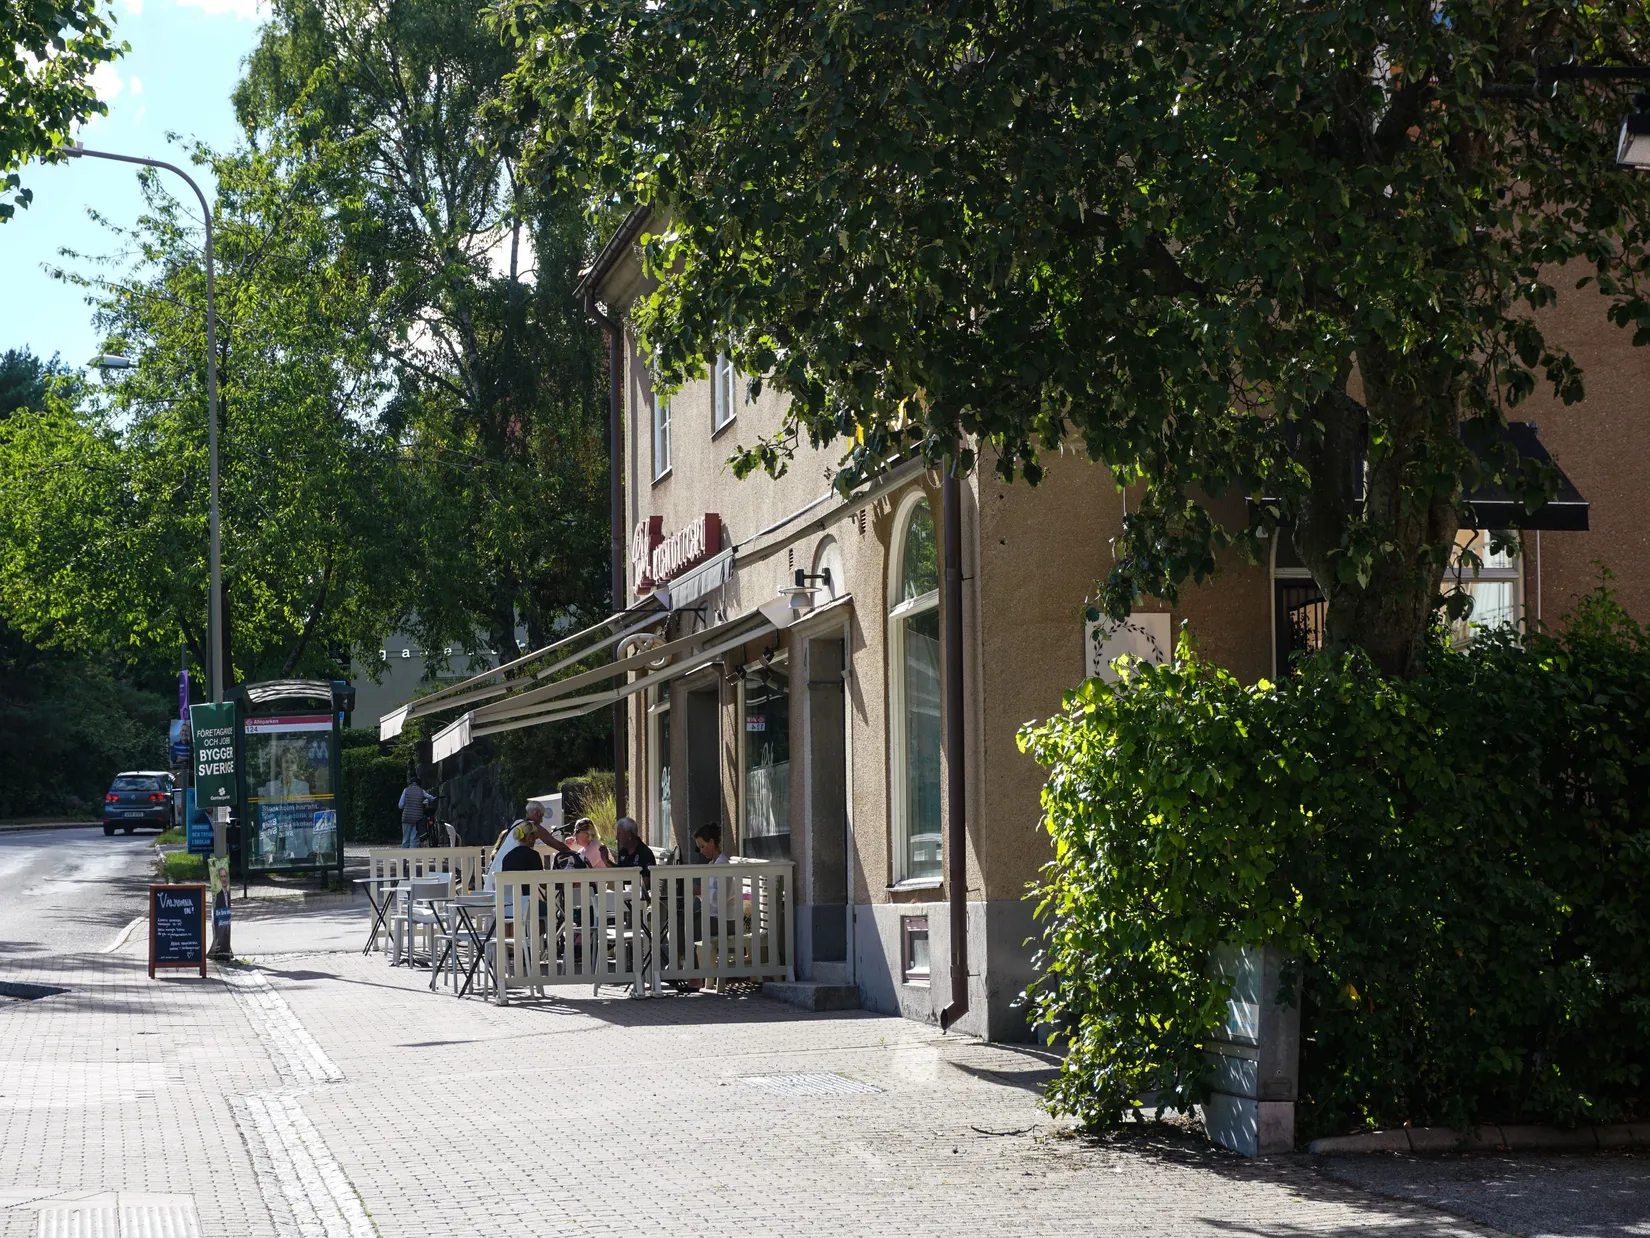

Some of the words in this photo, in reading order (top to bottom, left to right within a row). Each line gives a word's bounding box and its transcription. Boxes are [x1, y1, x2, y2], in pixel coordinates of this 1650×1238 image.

[196, 727, 233, 738] FÖRETAGANDE
[203, 739, 218, 747] OCH
[199, 747, 234, 762] BYGGER
[198, 761, 234, 776] SVERIGE
